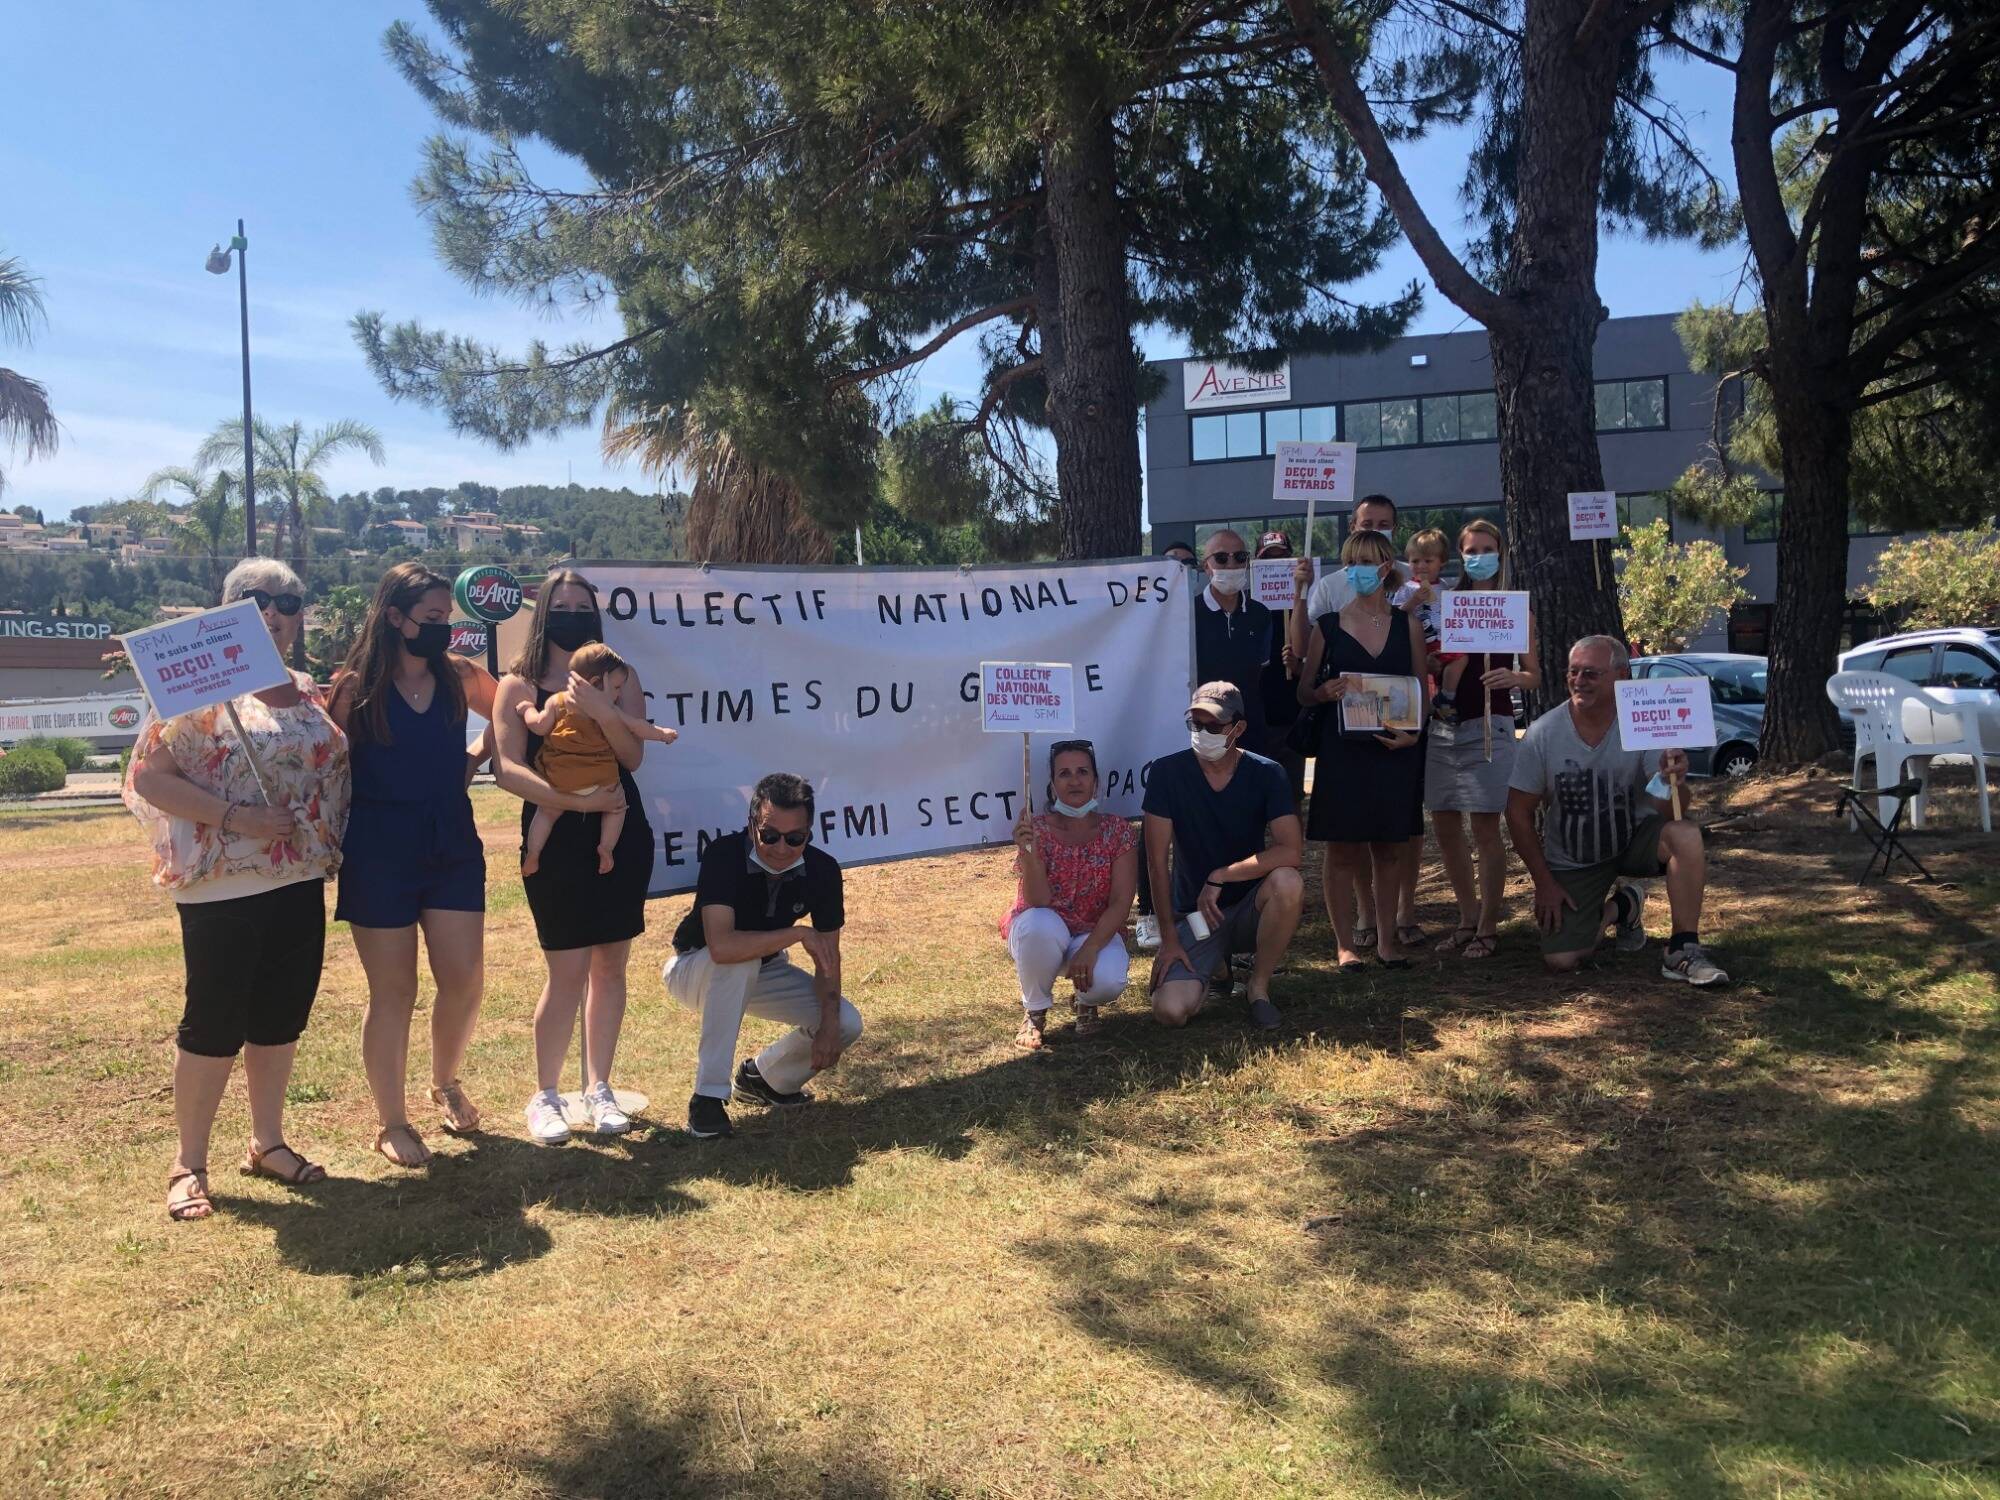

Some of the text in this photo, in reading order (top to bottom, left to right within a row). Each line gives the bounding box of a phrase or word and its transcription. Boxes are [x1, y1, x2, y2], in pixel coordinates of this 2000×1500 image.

[1190, 366, 1285, 402] AVENIR
[1285, 467, 1317, 479] DEÇU!
[1284, 479, 1335, 490] RETARDS
[1261, 581, 1290, 592] DEÇU!
[473, 582, 520, 612] ARTE
[606, 576, 1169, 627] OLLECTIF NATIONAL DES
[1262, 593, 1295, 602] MALFAÇO
[1453, 596, 1507, 607] COLLECTIF
[1453, 607, 1507, 619] NATIONAL
[0, 620, 43, 637] ING
[1444, 618, 1514, 630] DES VICTIMES
[155, 631, 233, 662] Je suis un client
[157, 652, 216, 684] DEÇU!
[210, 671, 221, 682] DE
[222, 664, 250, 679] RETARD
[995, 668, 1051, 681] COLLECTIF
[996, 681, 1052, 694] NATIONAL
[856, 682, 914, 718] DU
[987, 693, 1062, 707] DES VICTIMES
[32, 713, 52, 729] VOTRE
[78, 710, 98, 727] RESTE
[1034, 708, 1059, 720] SFMI
[1632, 709, 1671, 725] DEÇU!
[811, 802, 889, 844] FMI
